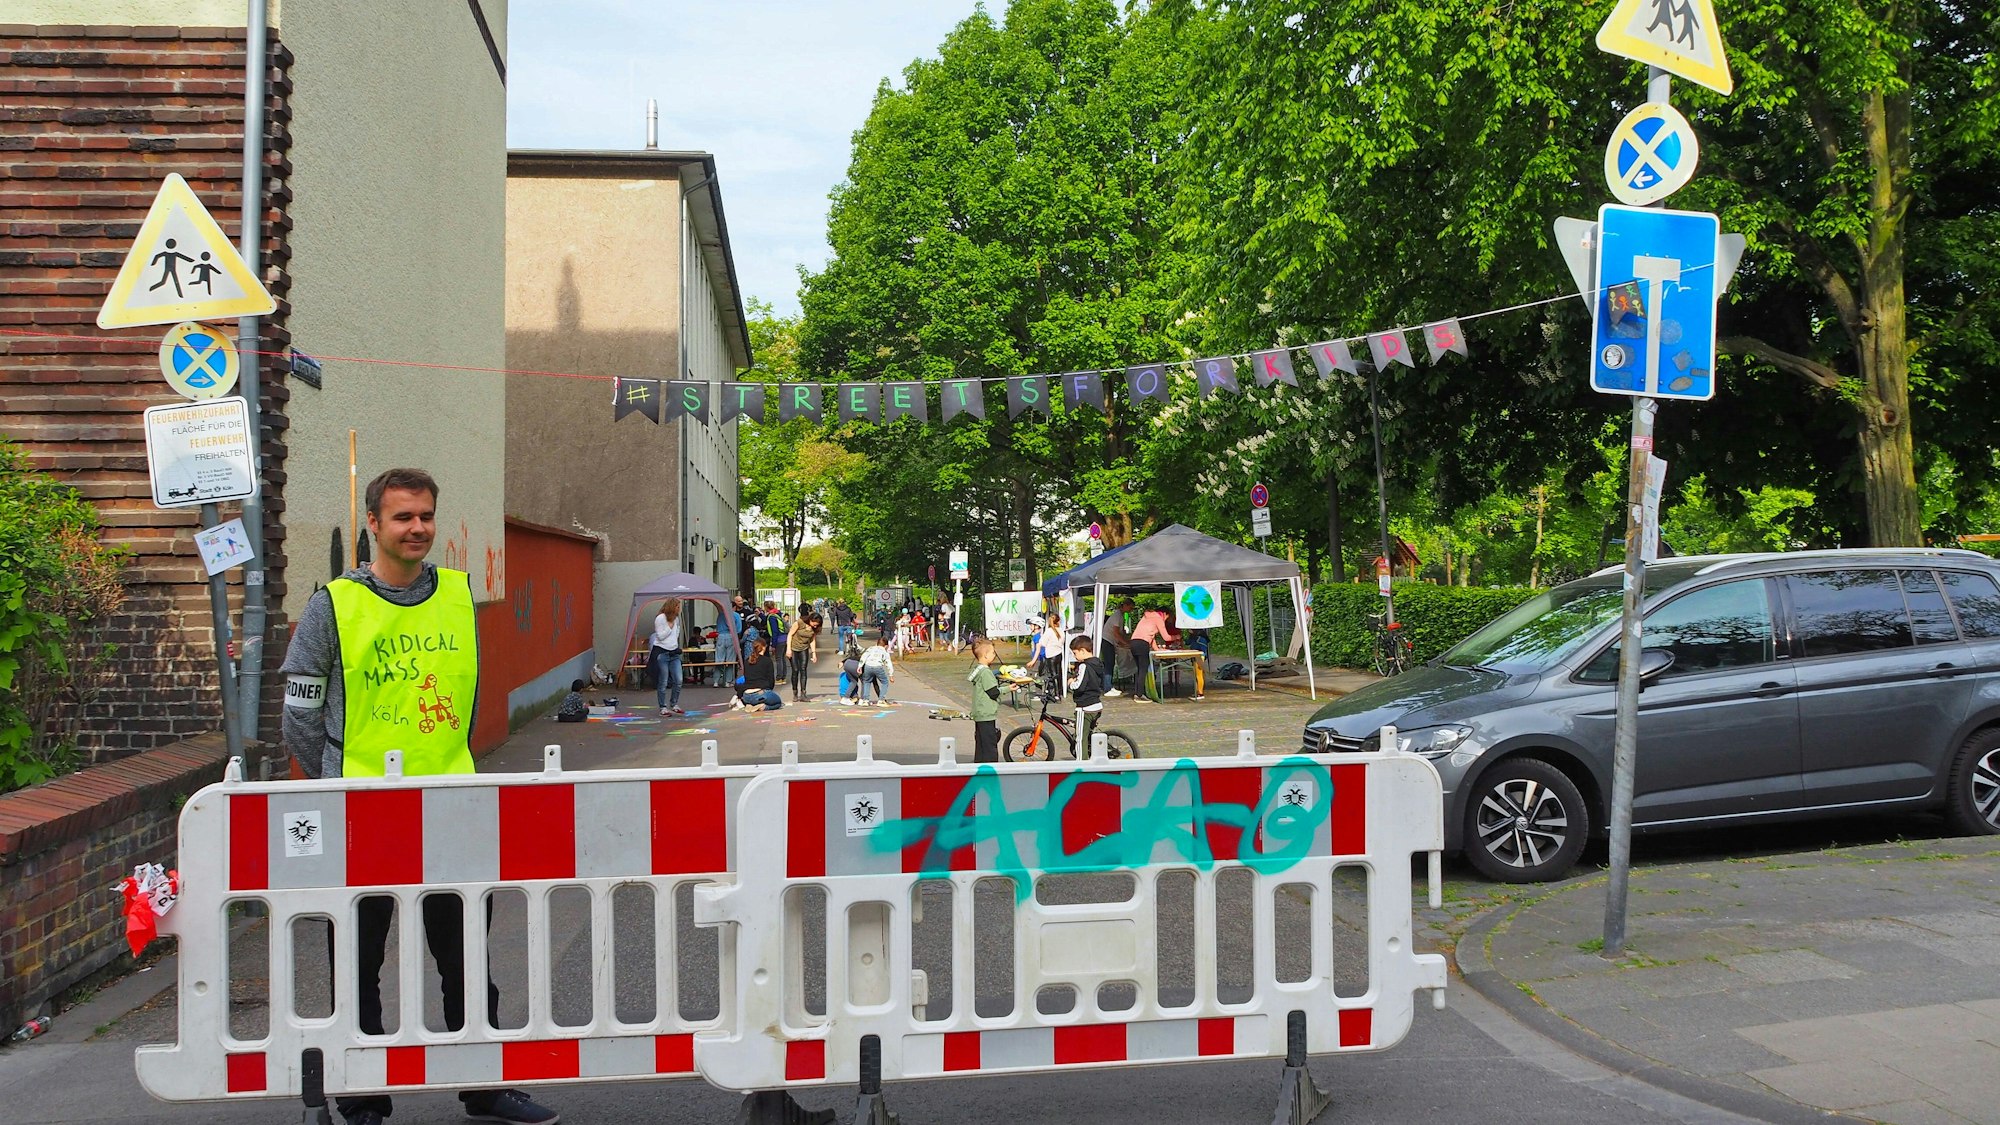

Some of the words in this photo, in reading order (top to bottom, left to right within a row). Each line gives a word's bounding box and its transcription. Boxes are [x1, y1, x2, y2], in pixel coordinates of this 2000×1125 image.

[151, 404, 241, 425] FEUERWEHRZUFAHRT
[208, 421, 226, 431] FÜR
[228, 419, 243, 429] DIE
[189, 433, 246, 449] FEUERWEHR
[195, 449, 246, 461] FREIHALTEN
[992, 599, 1018, 615] WIR
[374, 633, 459, 663] KIDICAL
[364, 657, 420, 691] MASS
[371, 704, 409, 726] Köln
